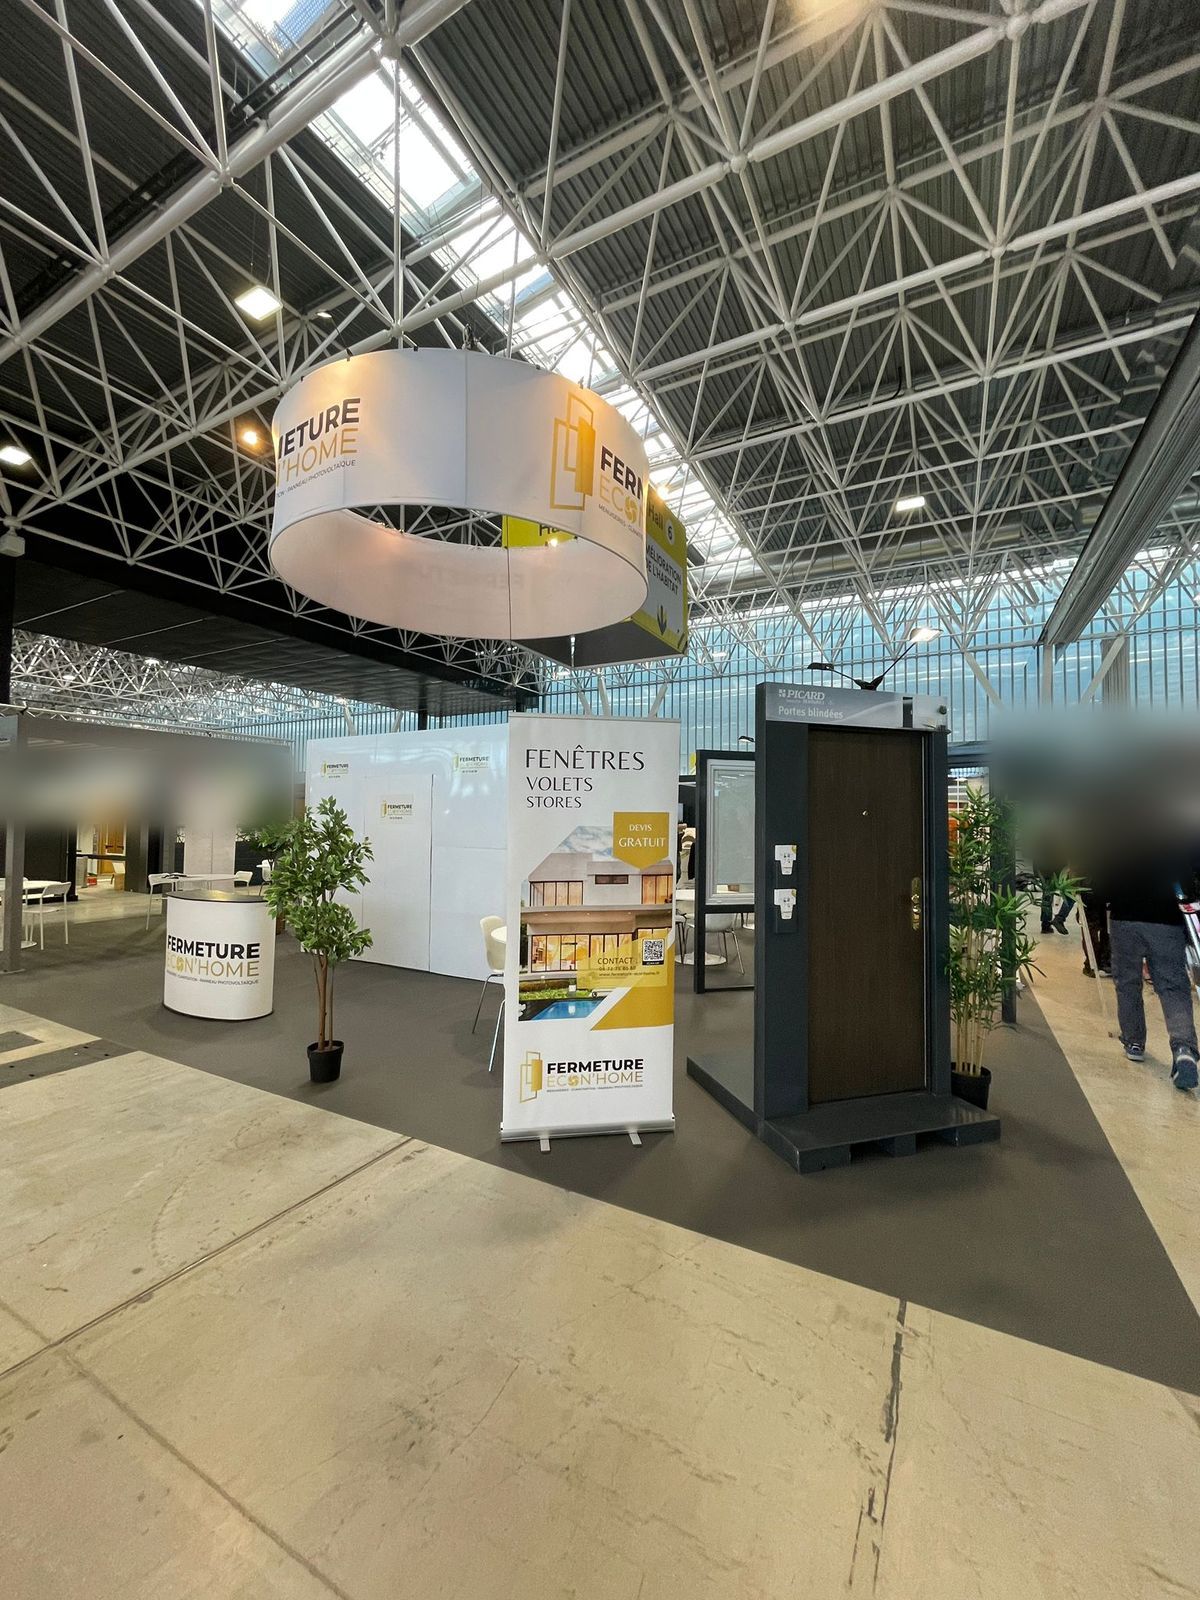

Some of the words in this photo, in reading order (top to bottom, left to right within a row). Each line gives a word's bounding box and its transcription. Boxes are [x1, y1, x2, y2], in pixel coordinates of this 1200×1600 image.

[787, 689, 825, 700] PICARD
[778, 706, 806, 717] Portes
[808, 707, 844, 719] blindées
[525, 744, 645, 771] FENÊTRES
[526, 776, 593, 792] VOLETS
[526, 796, 582, 808] STORES
[629, 823, 652, 831] DEVIS
[618, 837, 666, 847] GRATUIT
[167, 934, 260, 960] FERMETURE
[598, 957, 633, 965] CONTACT
[547, 1058, 644, 1075] FERMETURE
[546, 1070, 643, 1088] ECON'HOME
